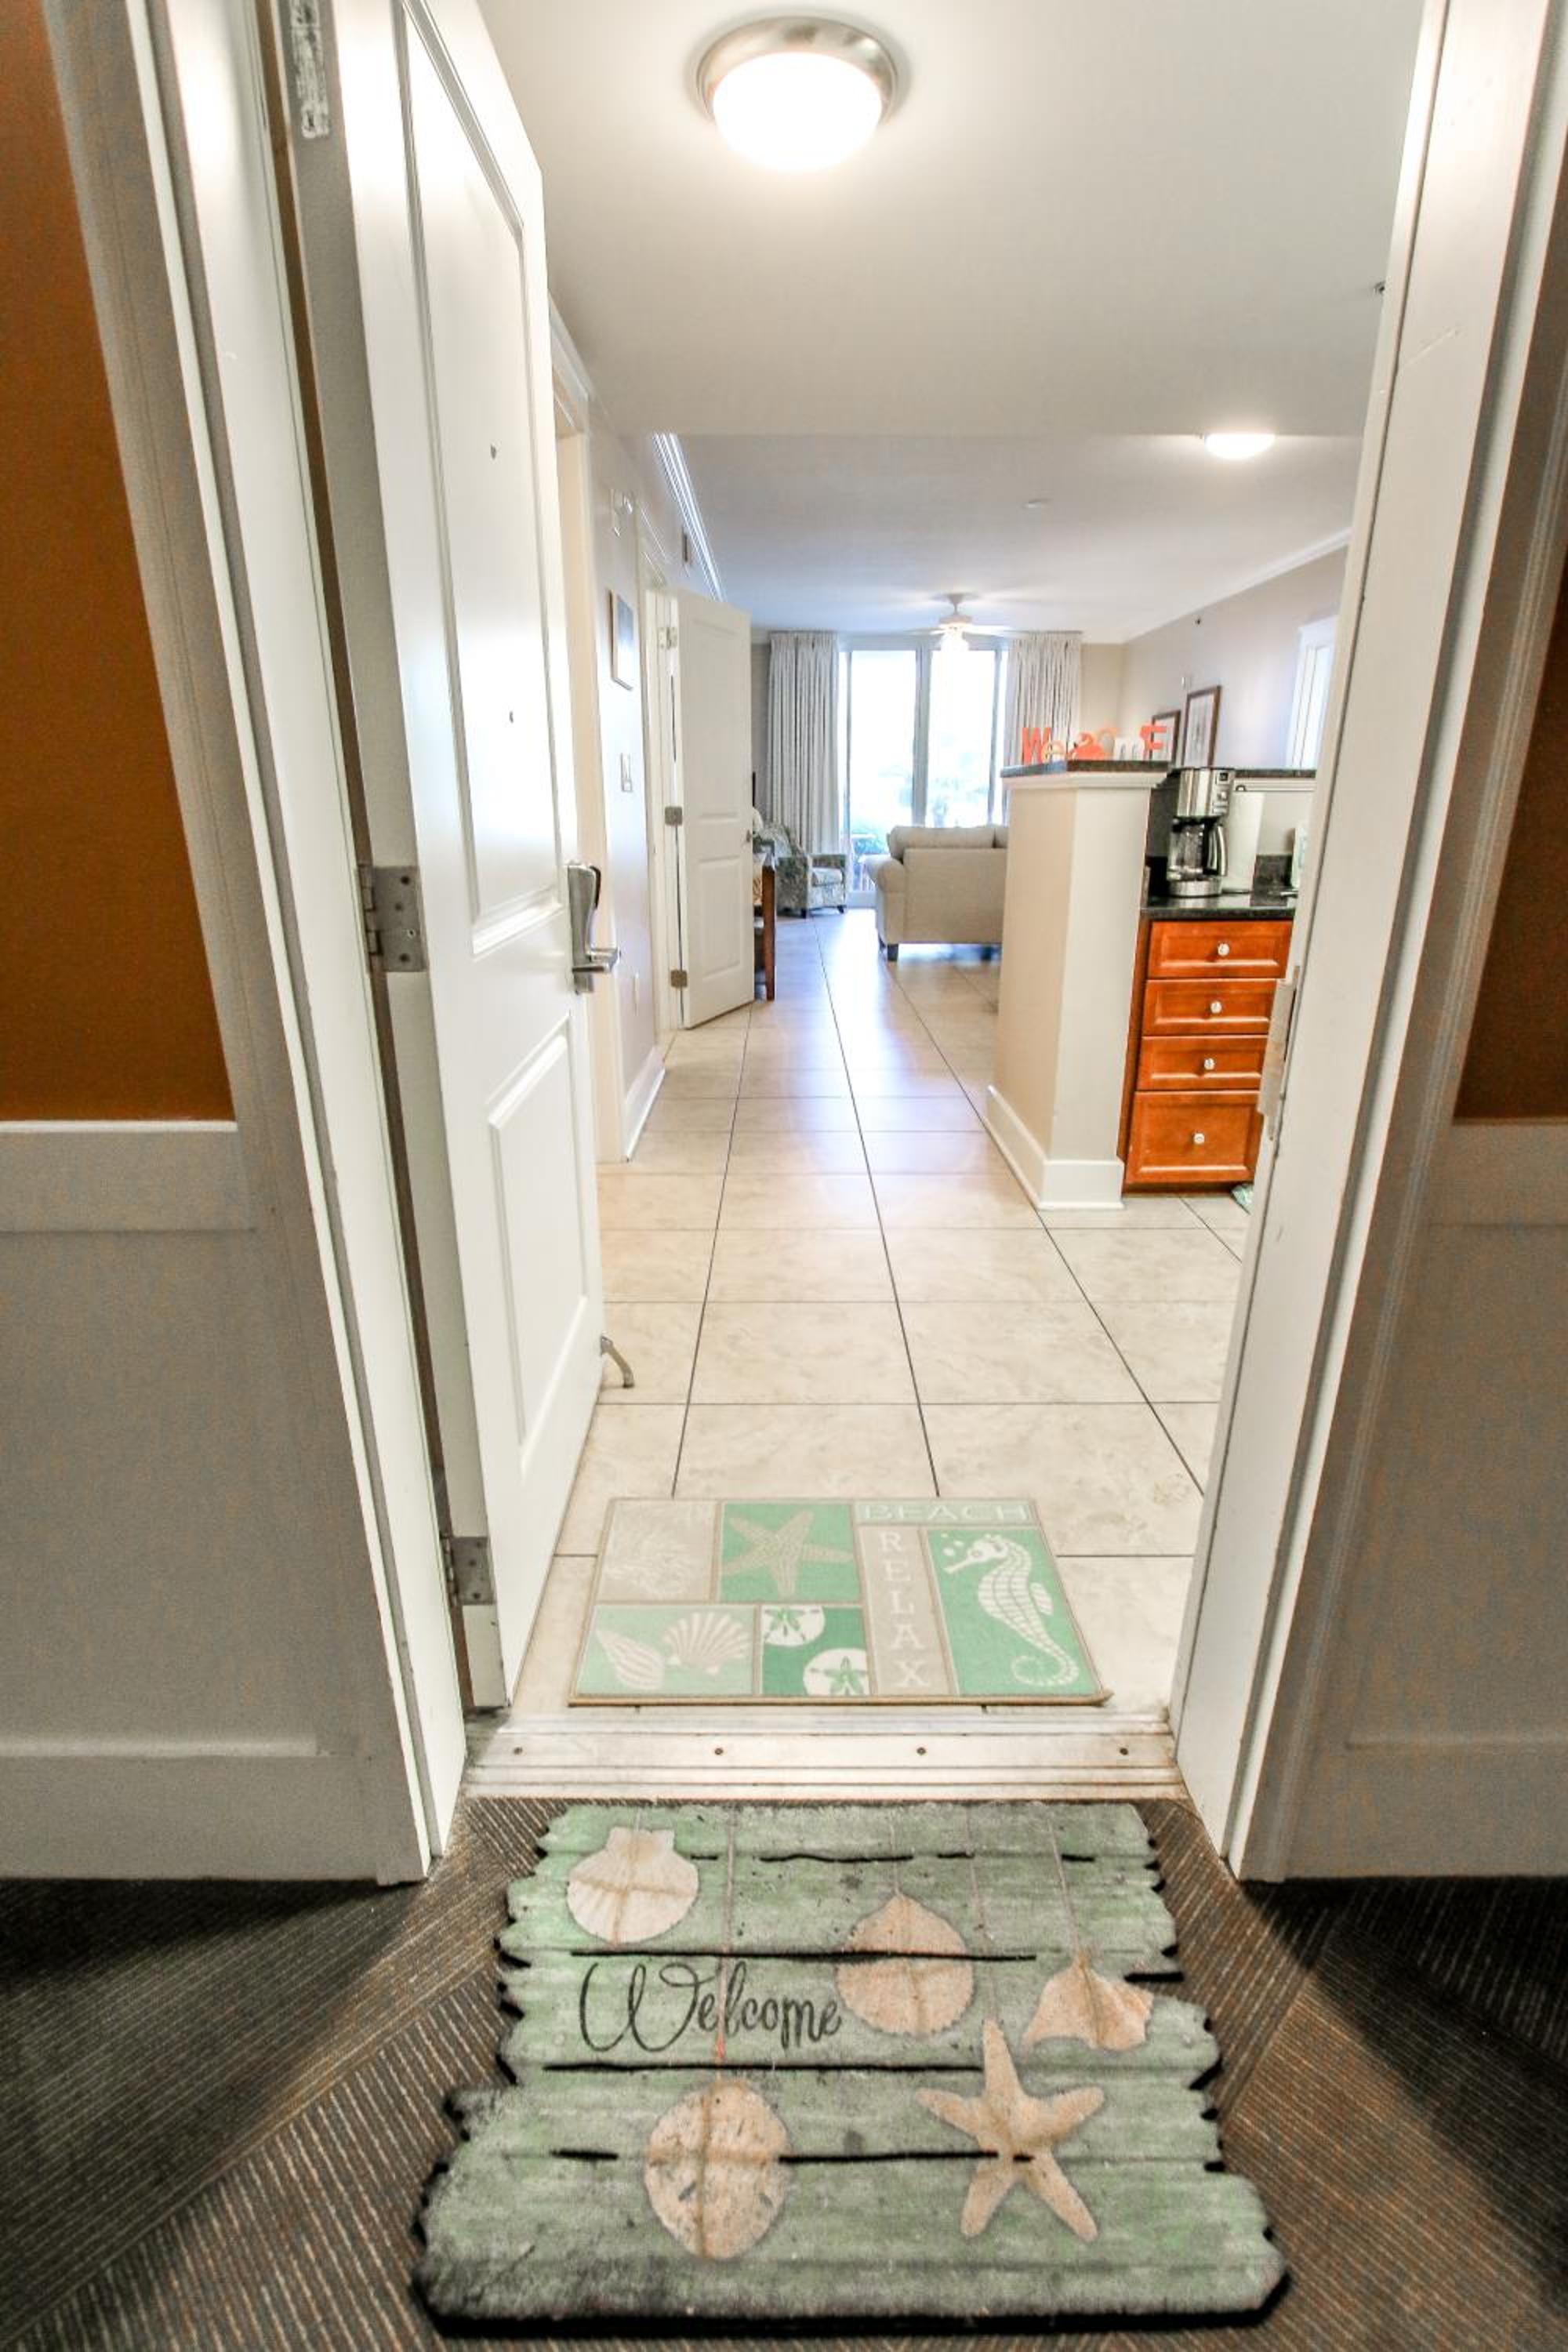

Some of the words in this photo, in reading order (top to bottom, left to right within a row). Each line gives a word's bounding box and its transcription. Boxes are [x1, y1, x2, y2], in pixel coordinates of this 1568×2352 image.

[863, 1504, 1028, 1521] BEACH
[878, 1531, 929, 1687] RELAX
[579, 1960, 842, 2052] Welcome
